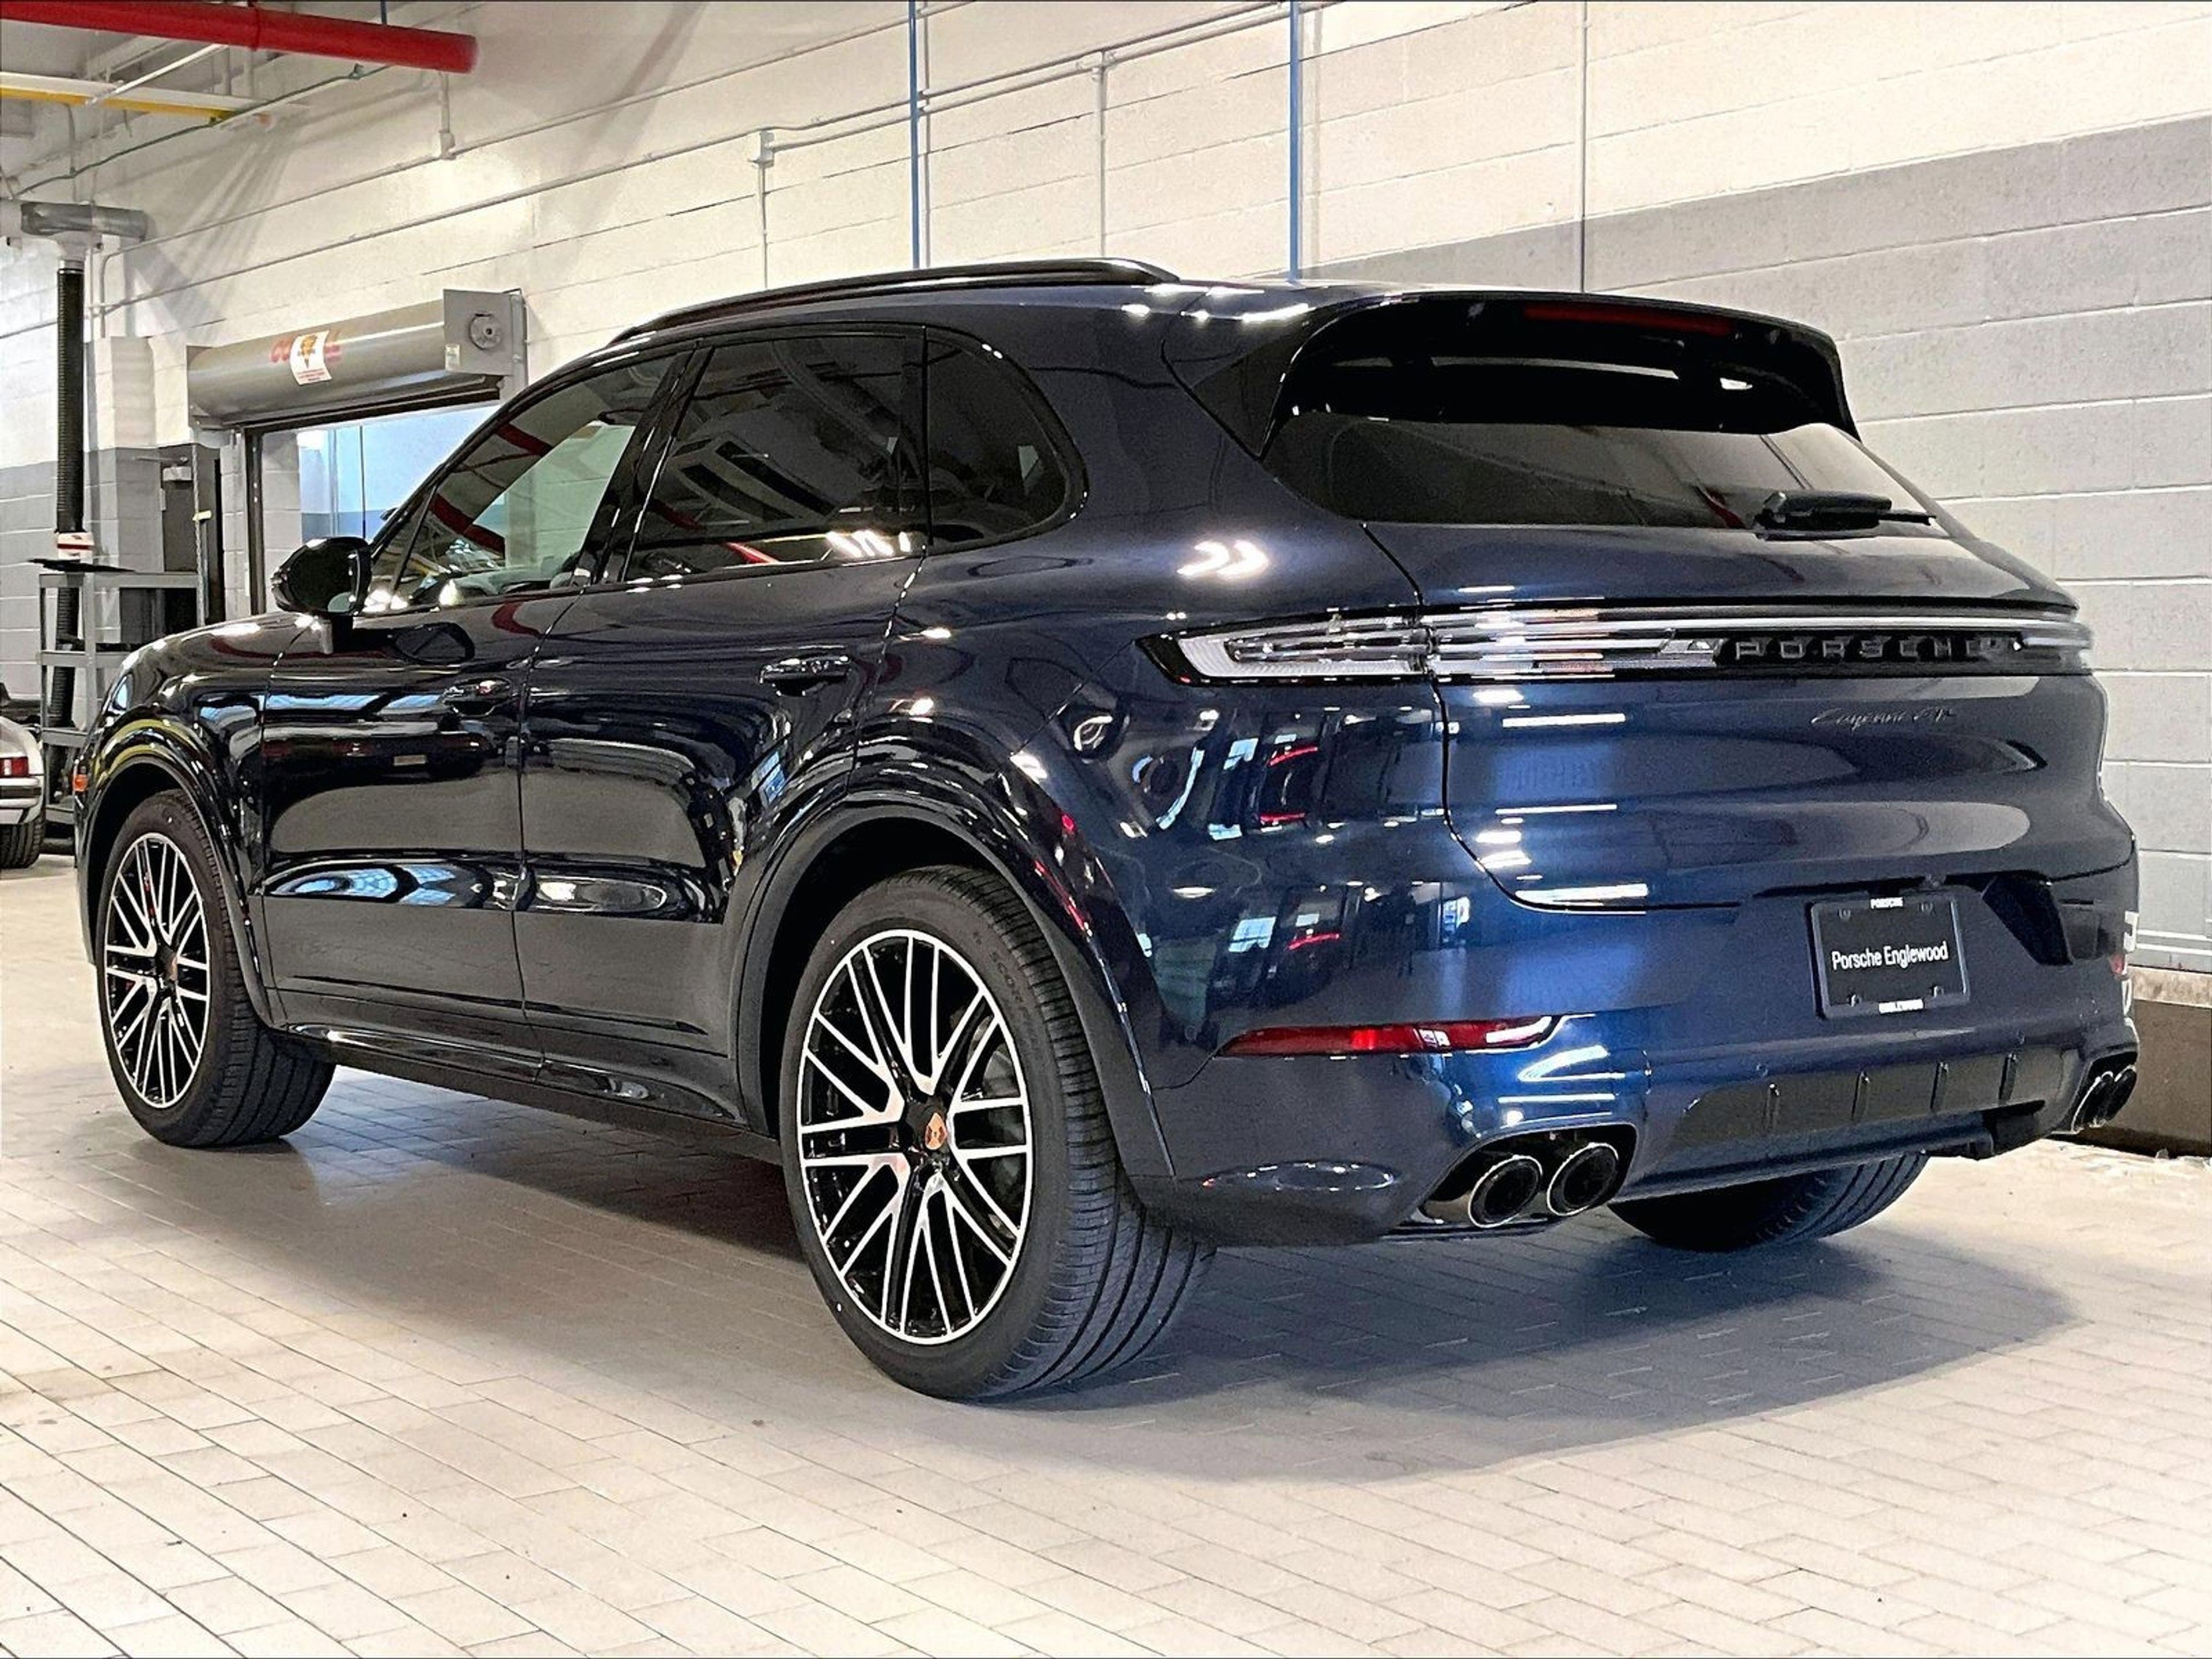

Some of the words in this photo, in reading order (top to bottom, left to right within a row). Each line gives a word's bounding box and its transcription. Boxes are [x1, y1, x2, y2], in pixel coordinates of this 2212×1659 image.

[1735, 638, 1982, 660] PORSCHE
[1831, 947, 1883, 971] Porsche
[1883, 940, 1949, 969] Englewood
